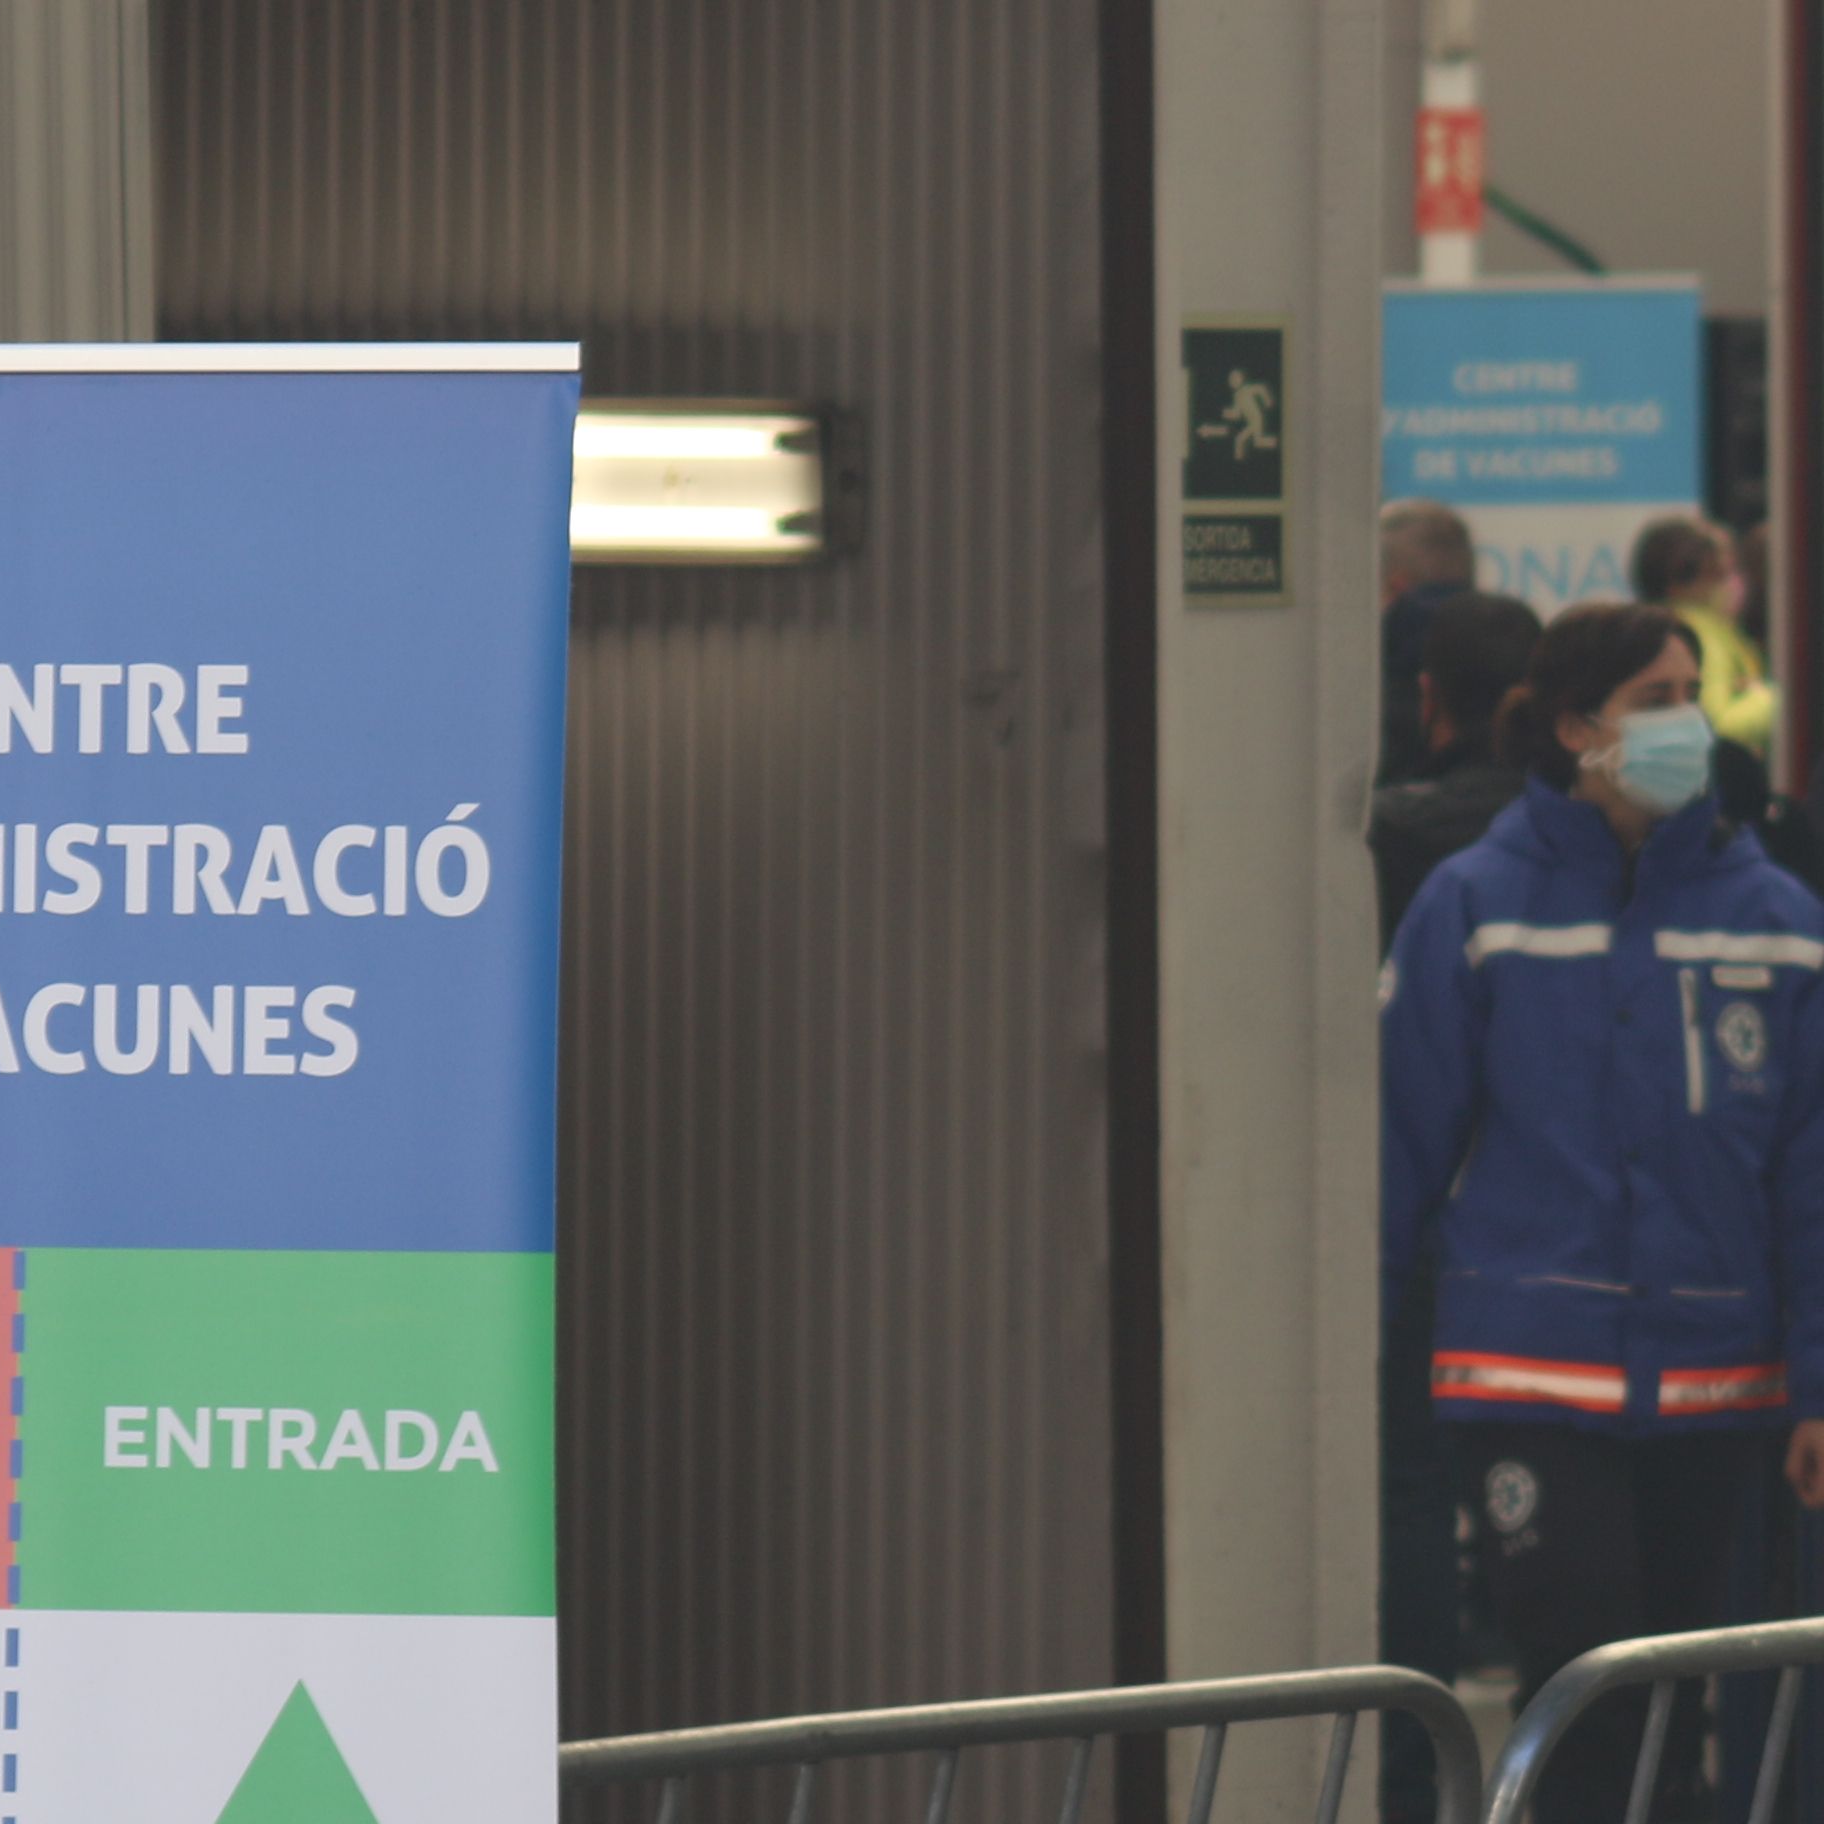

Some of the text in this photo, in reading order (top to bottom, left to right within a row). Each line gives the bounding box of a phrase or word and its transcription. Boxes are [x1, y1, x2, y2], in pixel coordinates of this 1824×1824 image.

[1453, 360, 1579, 394] CENTRE
[1414, 447, 1619, 480] DE VACUNES
[103, 1404, 499, 1474] ENTRADA
